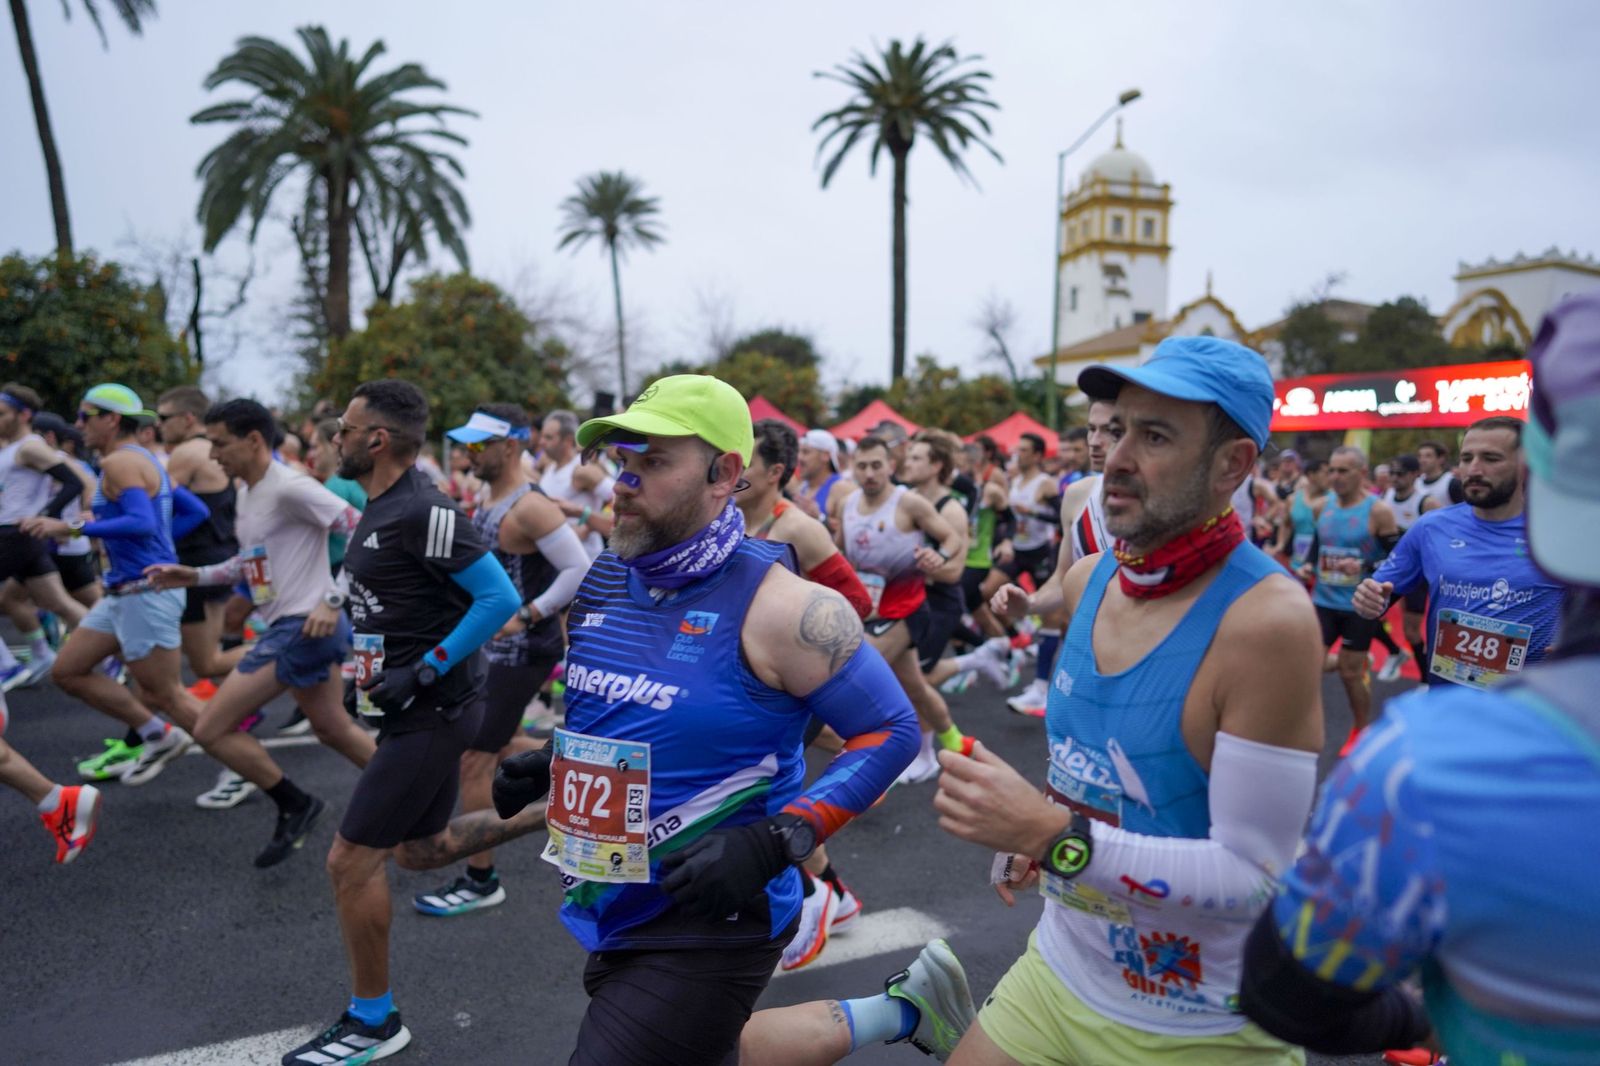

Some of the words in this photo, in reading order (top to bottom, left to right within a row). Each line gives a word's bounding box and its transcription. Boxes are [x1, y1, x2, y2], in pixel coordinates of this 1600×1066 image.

[1455, 630, 1500, 660] 248
[567, 663, 681, 711] enerplus
[563, 769, 611, 819] 672
